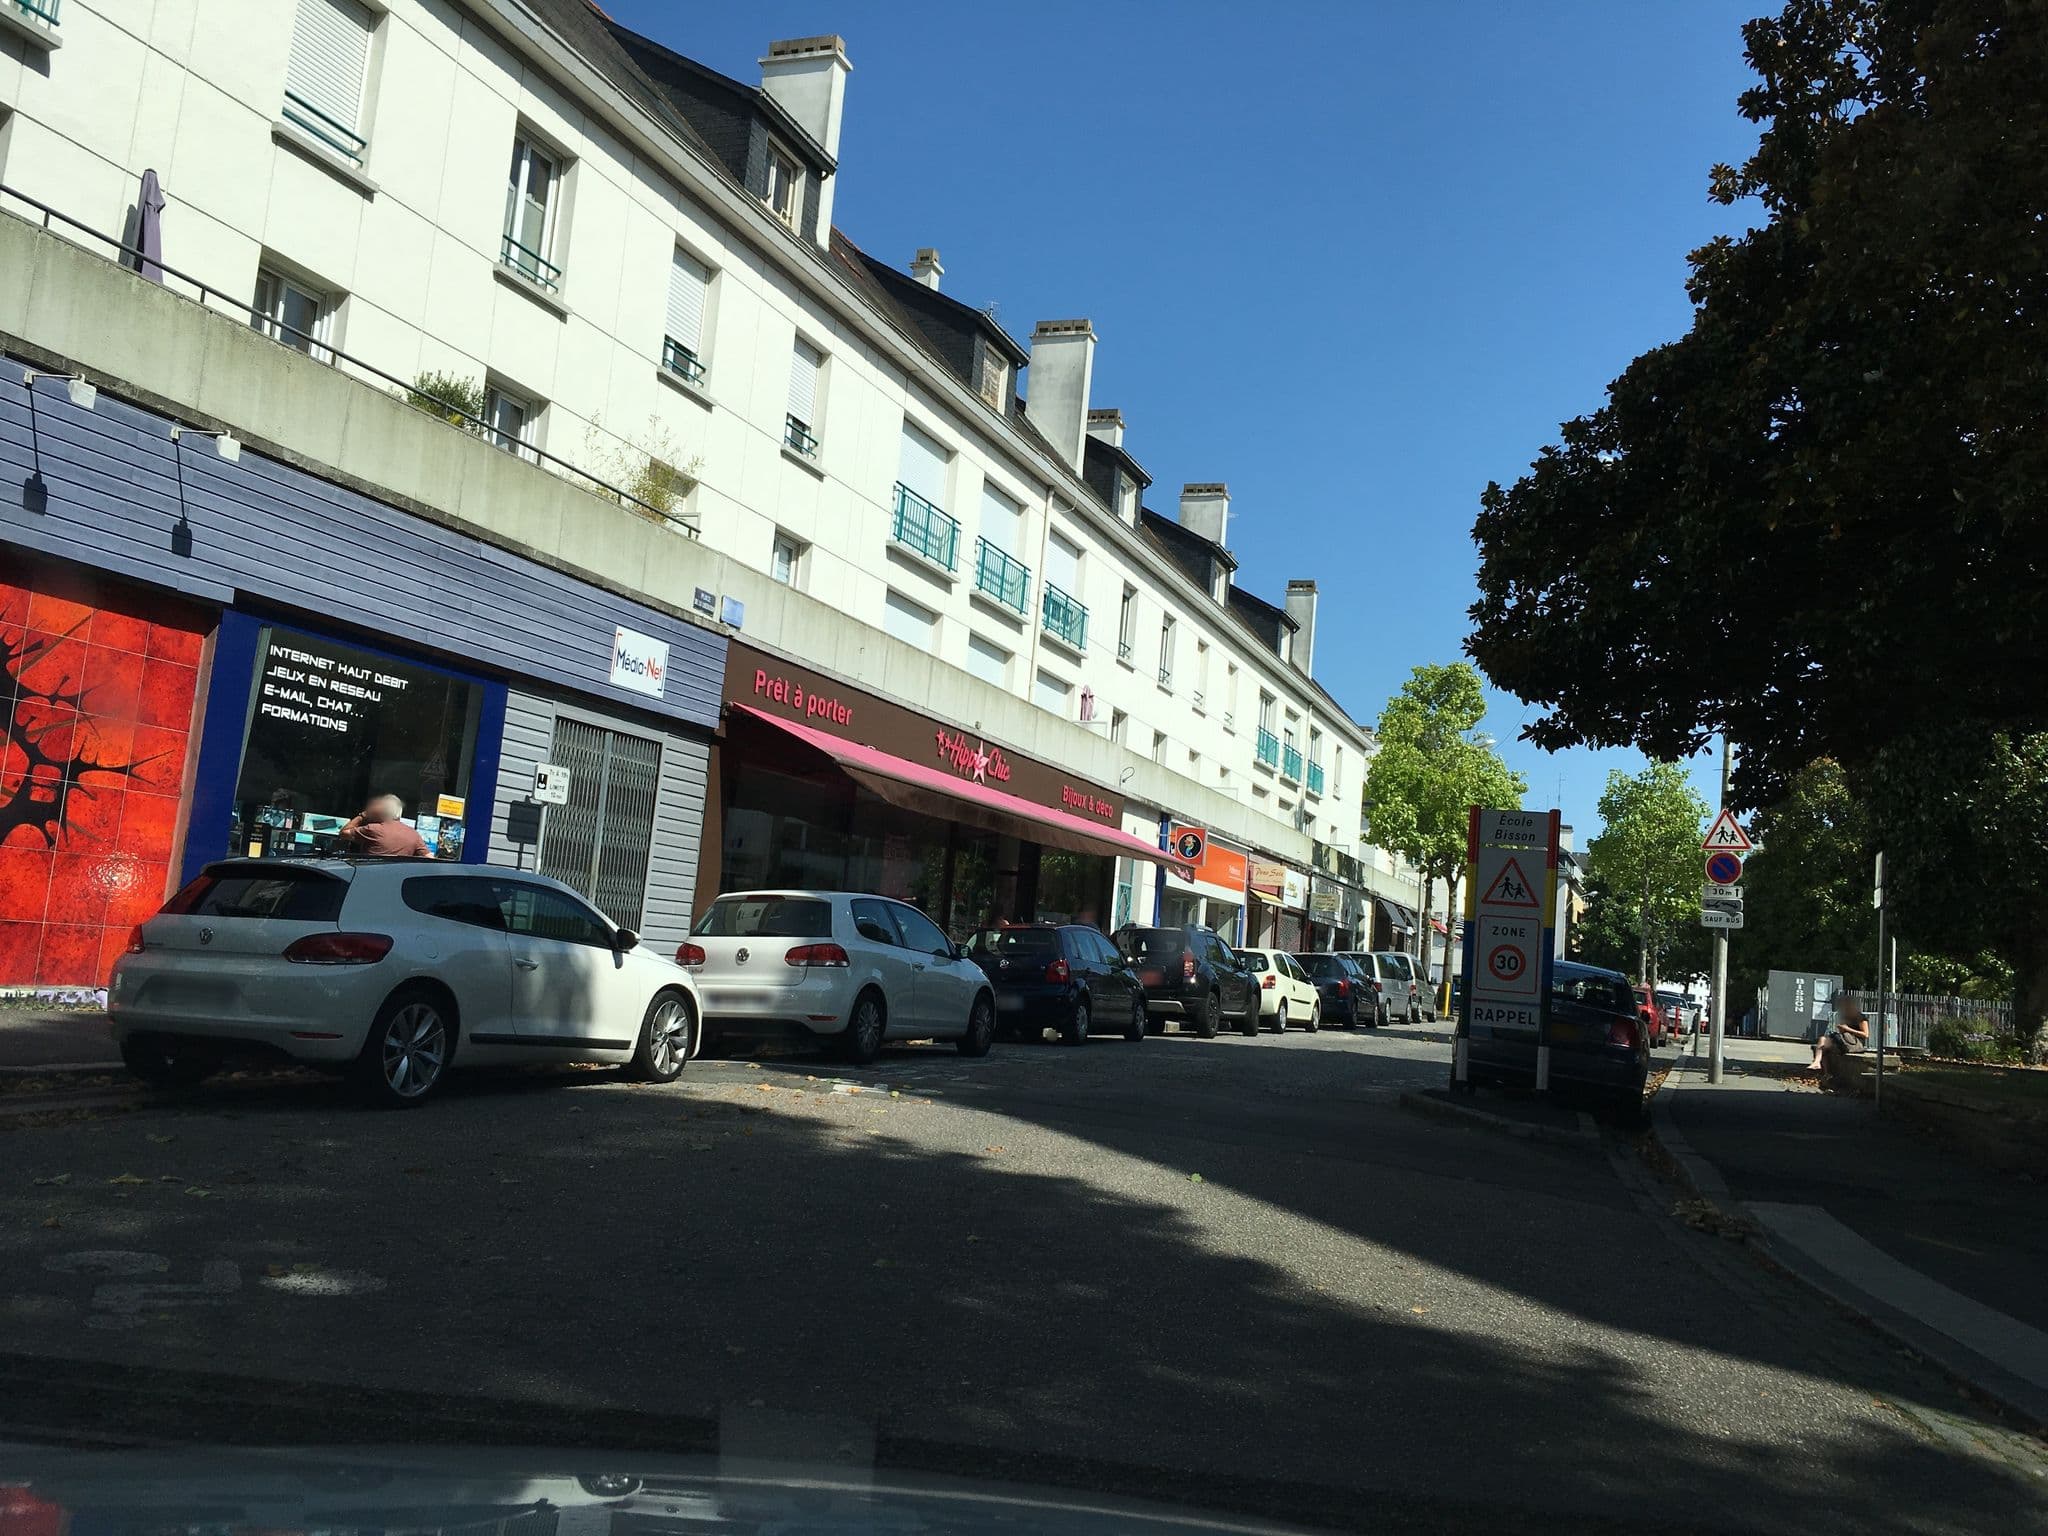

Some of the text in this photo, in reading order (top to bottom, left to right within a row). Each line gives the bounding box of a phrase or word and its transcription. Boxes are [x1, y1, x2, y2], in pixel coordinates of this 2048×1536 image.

[270, 644, 408, 690] INTERNET HAUT DEBIT
[264, 683, 313, 708] E-MAIL,
[267, 665, 382, 702] JEUX EN RESEAU
[755, 669, 853, 726] Prêt à porter
[261, 703, 348, 732] FORMATIONS
[988, 747, 1010, 781] Chic
[1063, 784, 1087, 809] Bijoux
[1500, 812, 1533, 827] École
[1495, 829, 1536, 842] Bisson
[1492, 926, 1526, 938] ZONE
[1496, 955, 1519, 971] 30
[1794, 978, 1805, 1012] BISSON
[1474, 1007, 1536, 1026] RAPPEL
